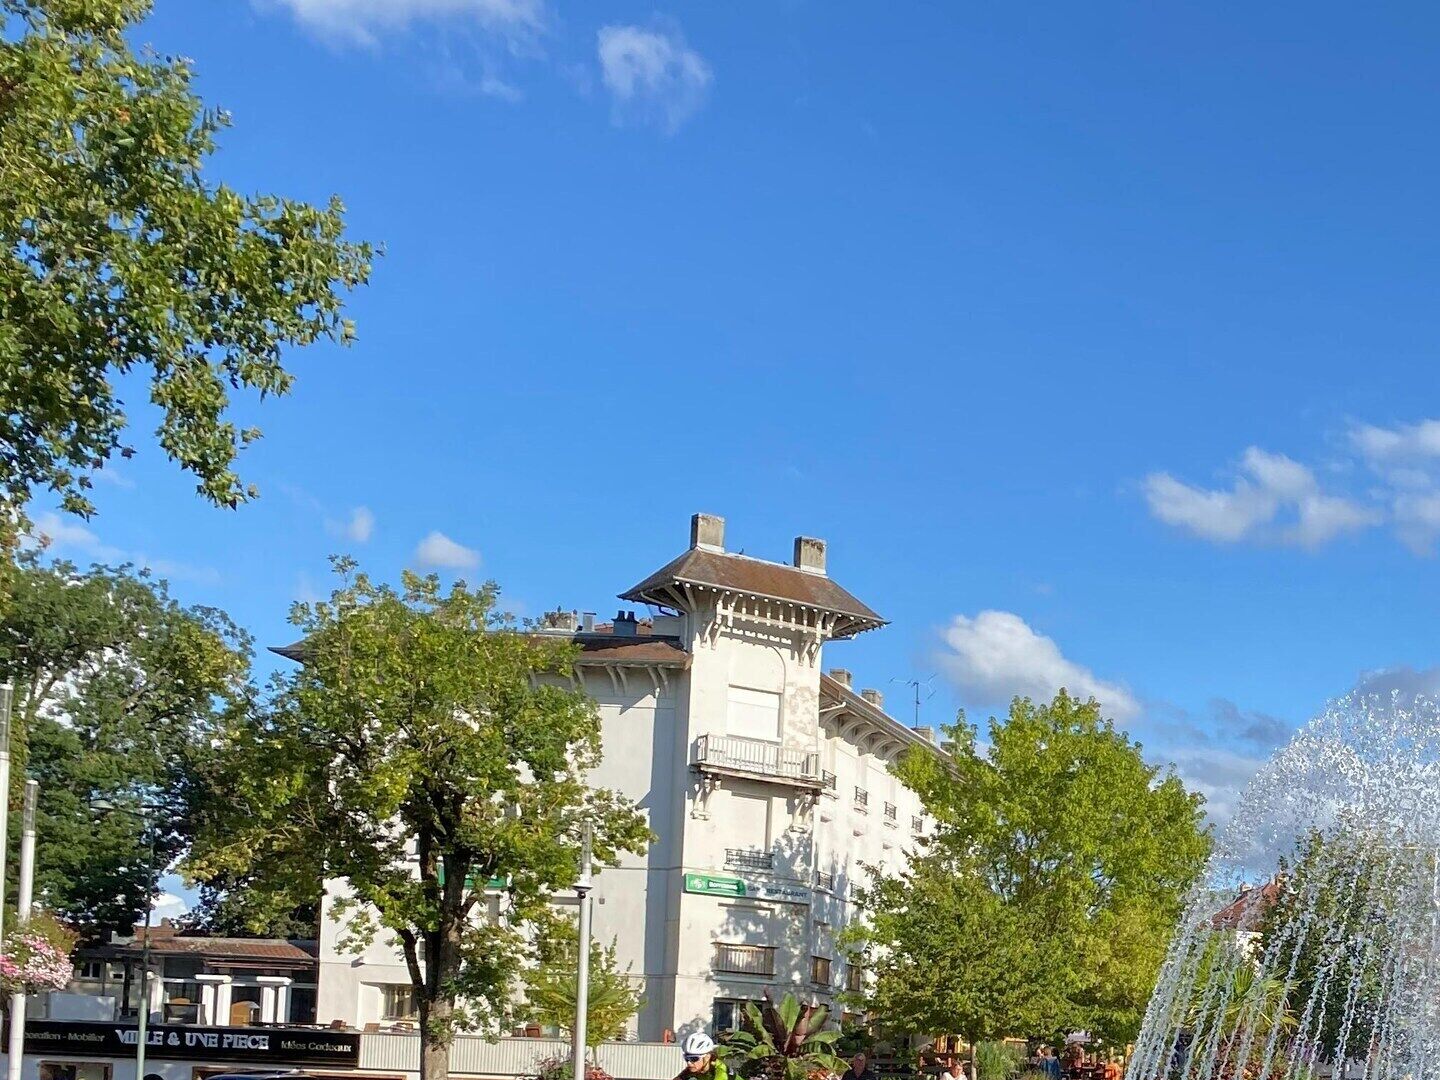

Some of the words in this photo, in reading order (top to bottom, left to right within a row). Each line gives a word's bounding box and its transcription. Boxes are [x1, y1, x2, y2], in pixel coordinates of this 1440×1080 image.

[115, 1029, 164, 1046] MILE
[167, 1031, 181, 1046] &
[185, 1032, 218, 1048] UNE
[222, 1033, 270, 1050] PIECE
[308, 1042, 352, 1053] Cadeaux
